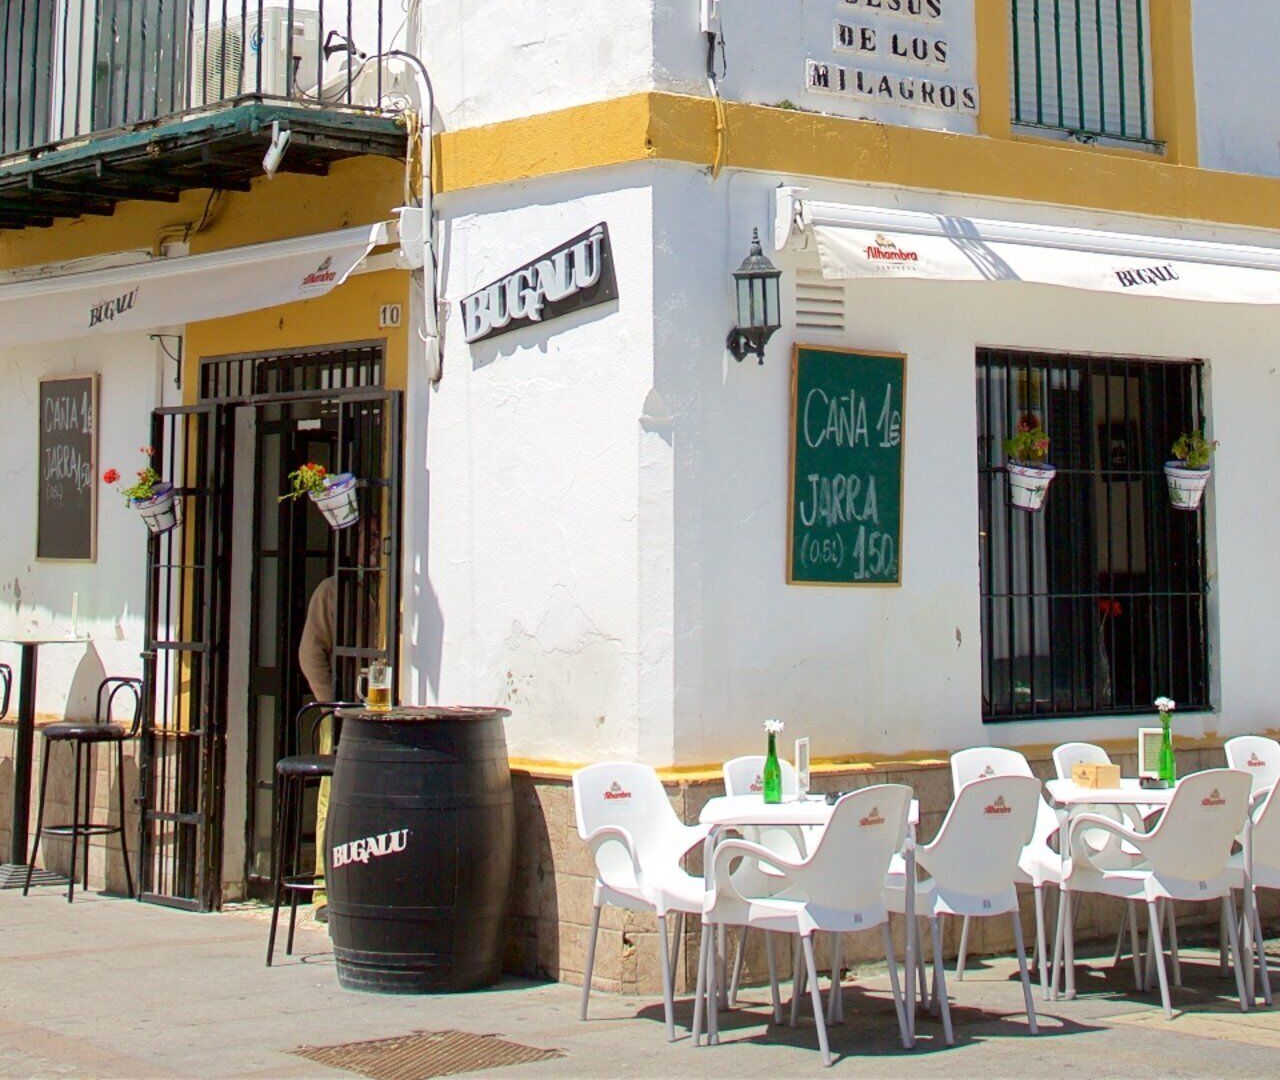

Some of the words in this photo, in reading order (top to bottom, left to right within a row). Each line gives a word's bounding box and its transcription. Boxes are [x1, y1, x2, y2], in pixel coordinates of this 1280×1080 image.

[838, 23, 877, 52] DE
[891, 32, 948, 63] LOS
[811, 63, 977, 110] MILAGROS
[863, 246, 919, 262] Alhambra
[463, 225, 605, 344] BUGALÚ
[1114, 262, 1180, 288] BUGALÚ
[88, 285, 140, 329] BUGALÚ
[380, 306, 400, 325] 10
[44, 396, 79, 434] CAÑA
[804, 387, 869, 448] CAÑA
[43, 444, 78, 481] JARRA
[800, 473, 879, 527] JARRA
